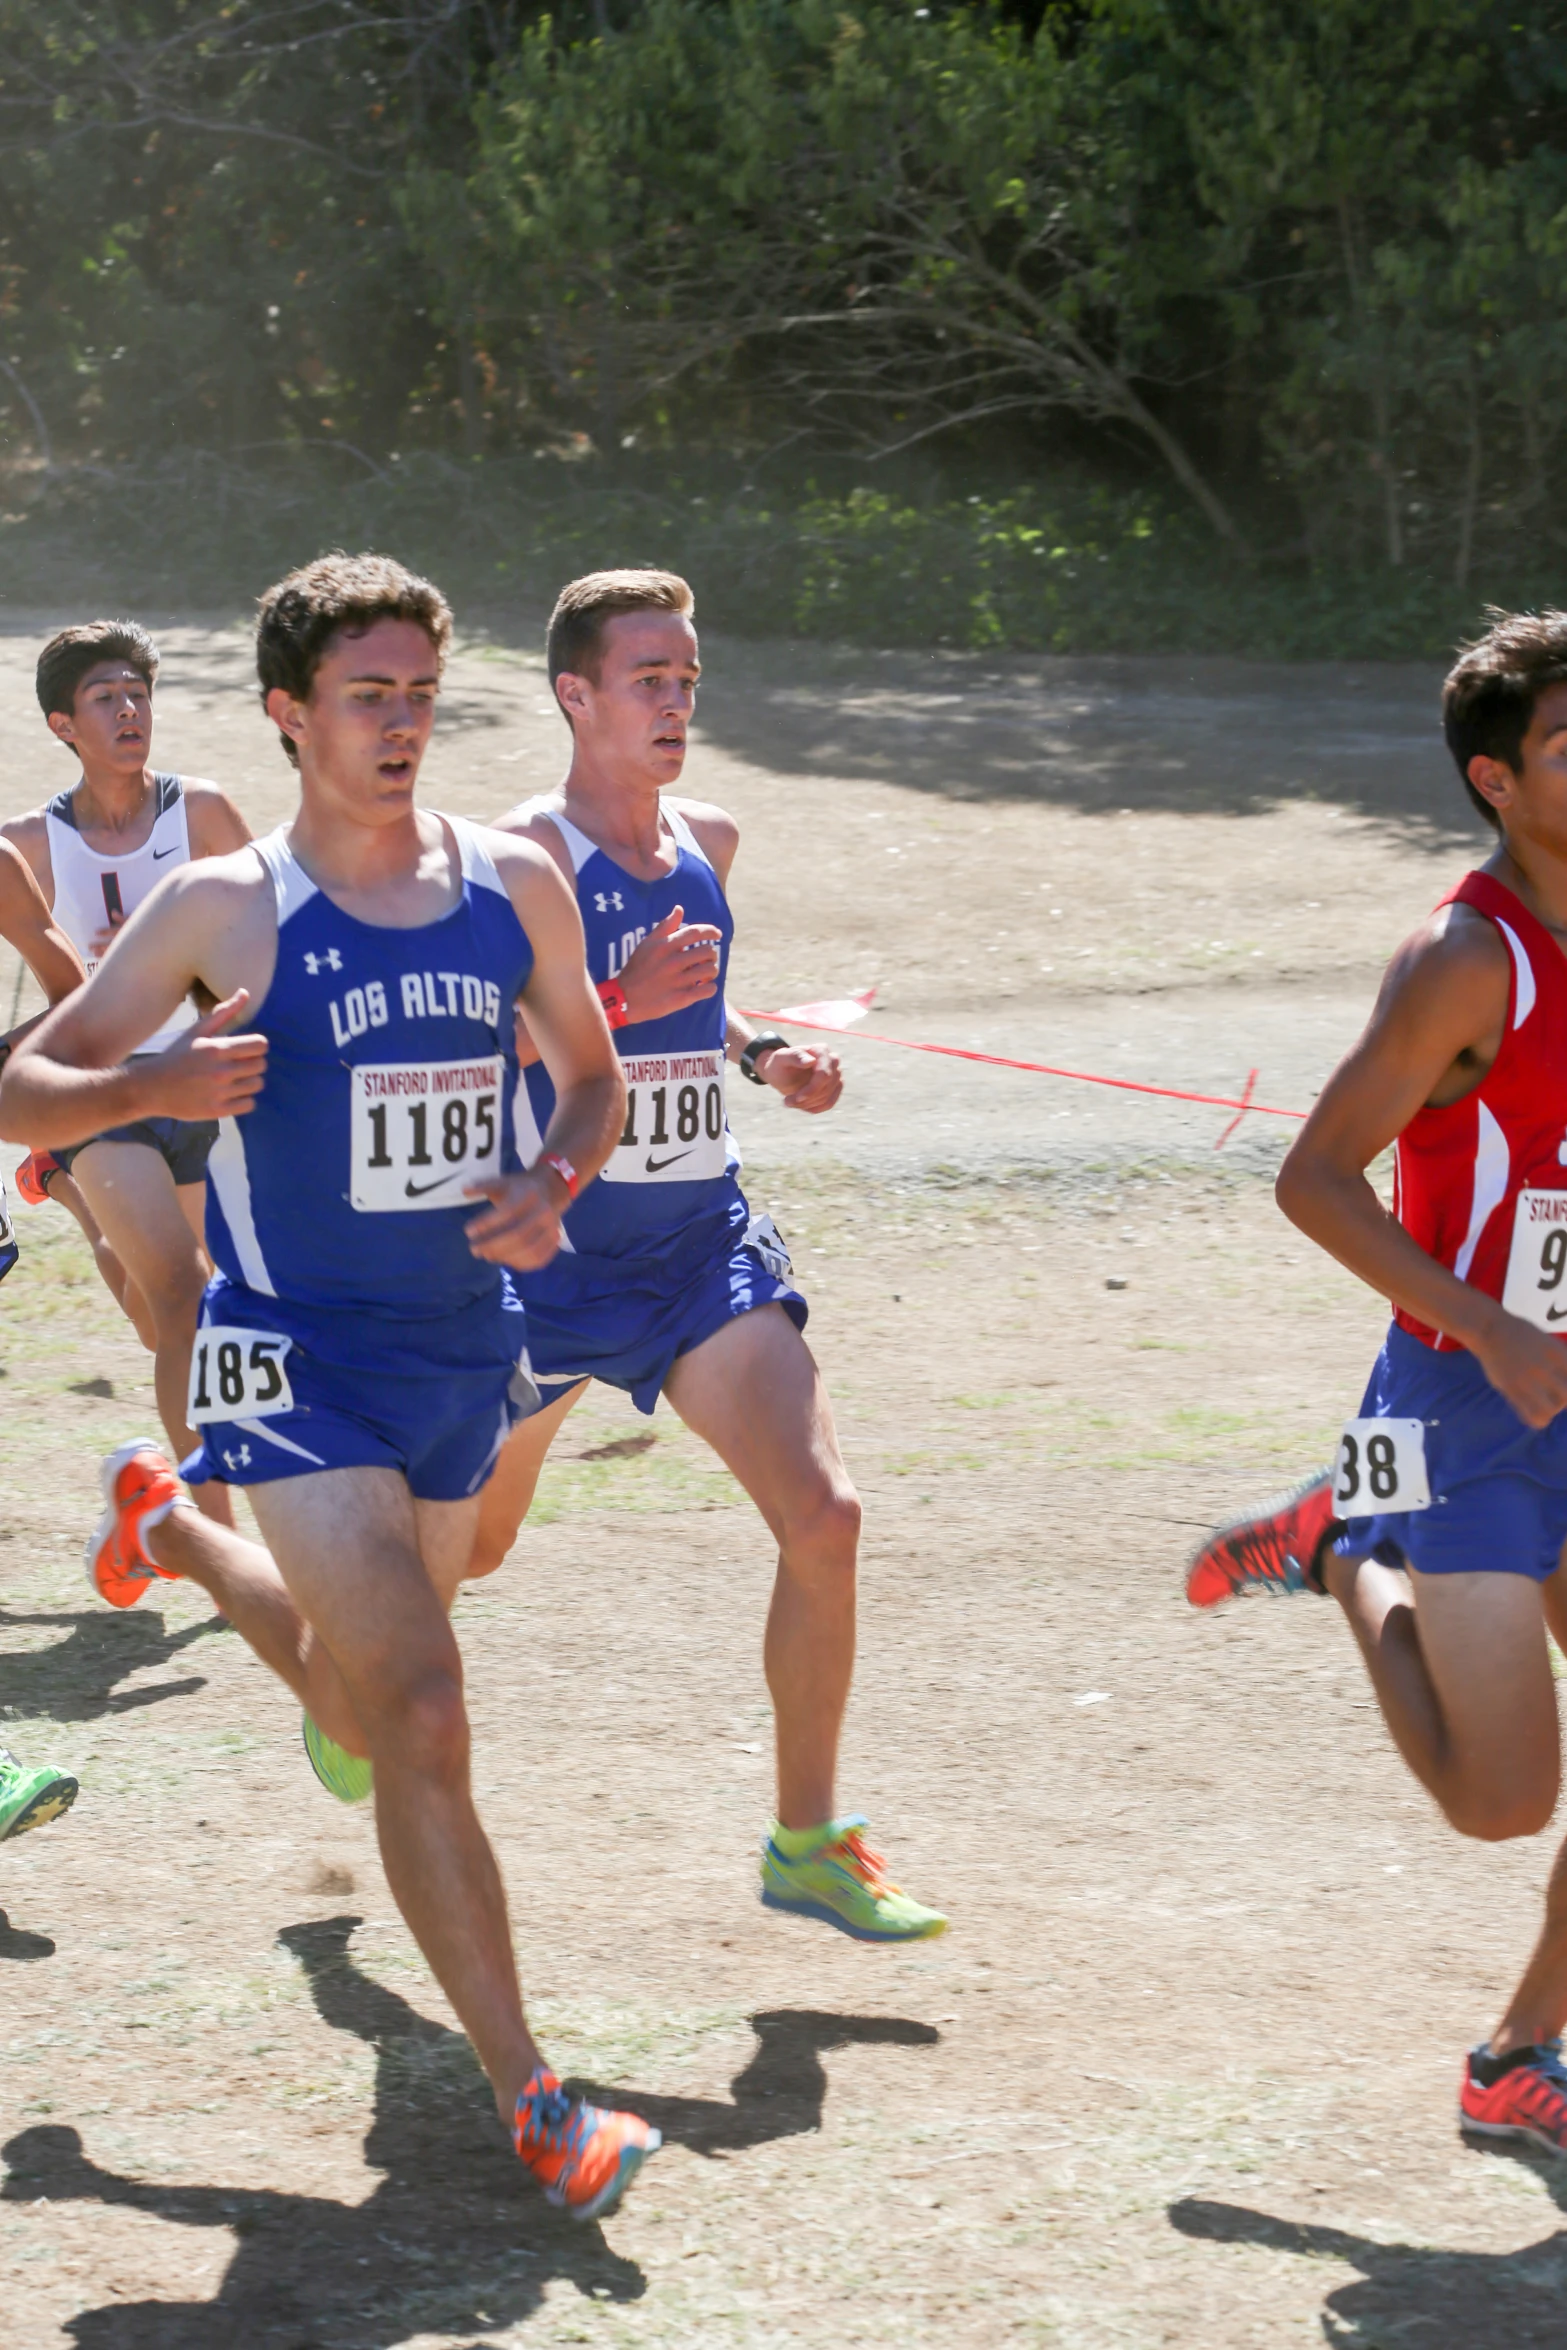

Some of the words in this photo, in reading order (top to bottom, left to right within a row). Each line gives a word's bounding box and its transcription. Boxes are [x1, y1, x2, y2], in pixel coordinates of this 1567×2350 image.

[329, 980, 389, 1049] LOS
[400, 971, 501, 1029] ALTOS
[364, 1071, 428, 1097] STANFORD
[431, 1064, 497, 1094] INVITATIONAL
[622, 1060, 668, 1084] TANFORD
[669, 1056, 719, 1081] INVITATIONAL
[367, 1094, 496, 1168] 1185
[617, 1082, 721, 1147] 1180
[193, 1340, 283, 1409] 185
